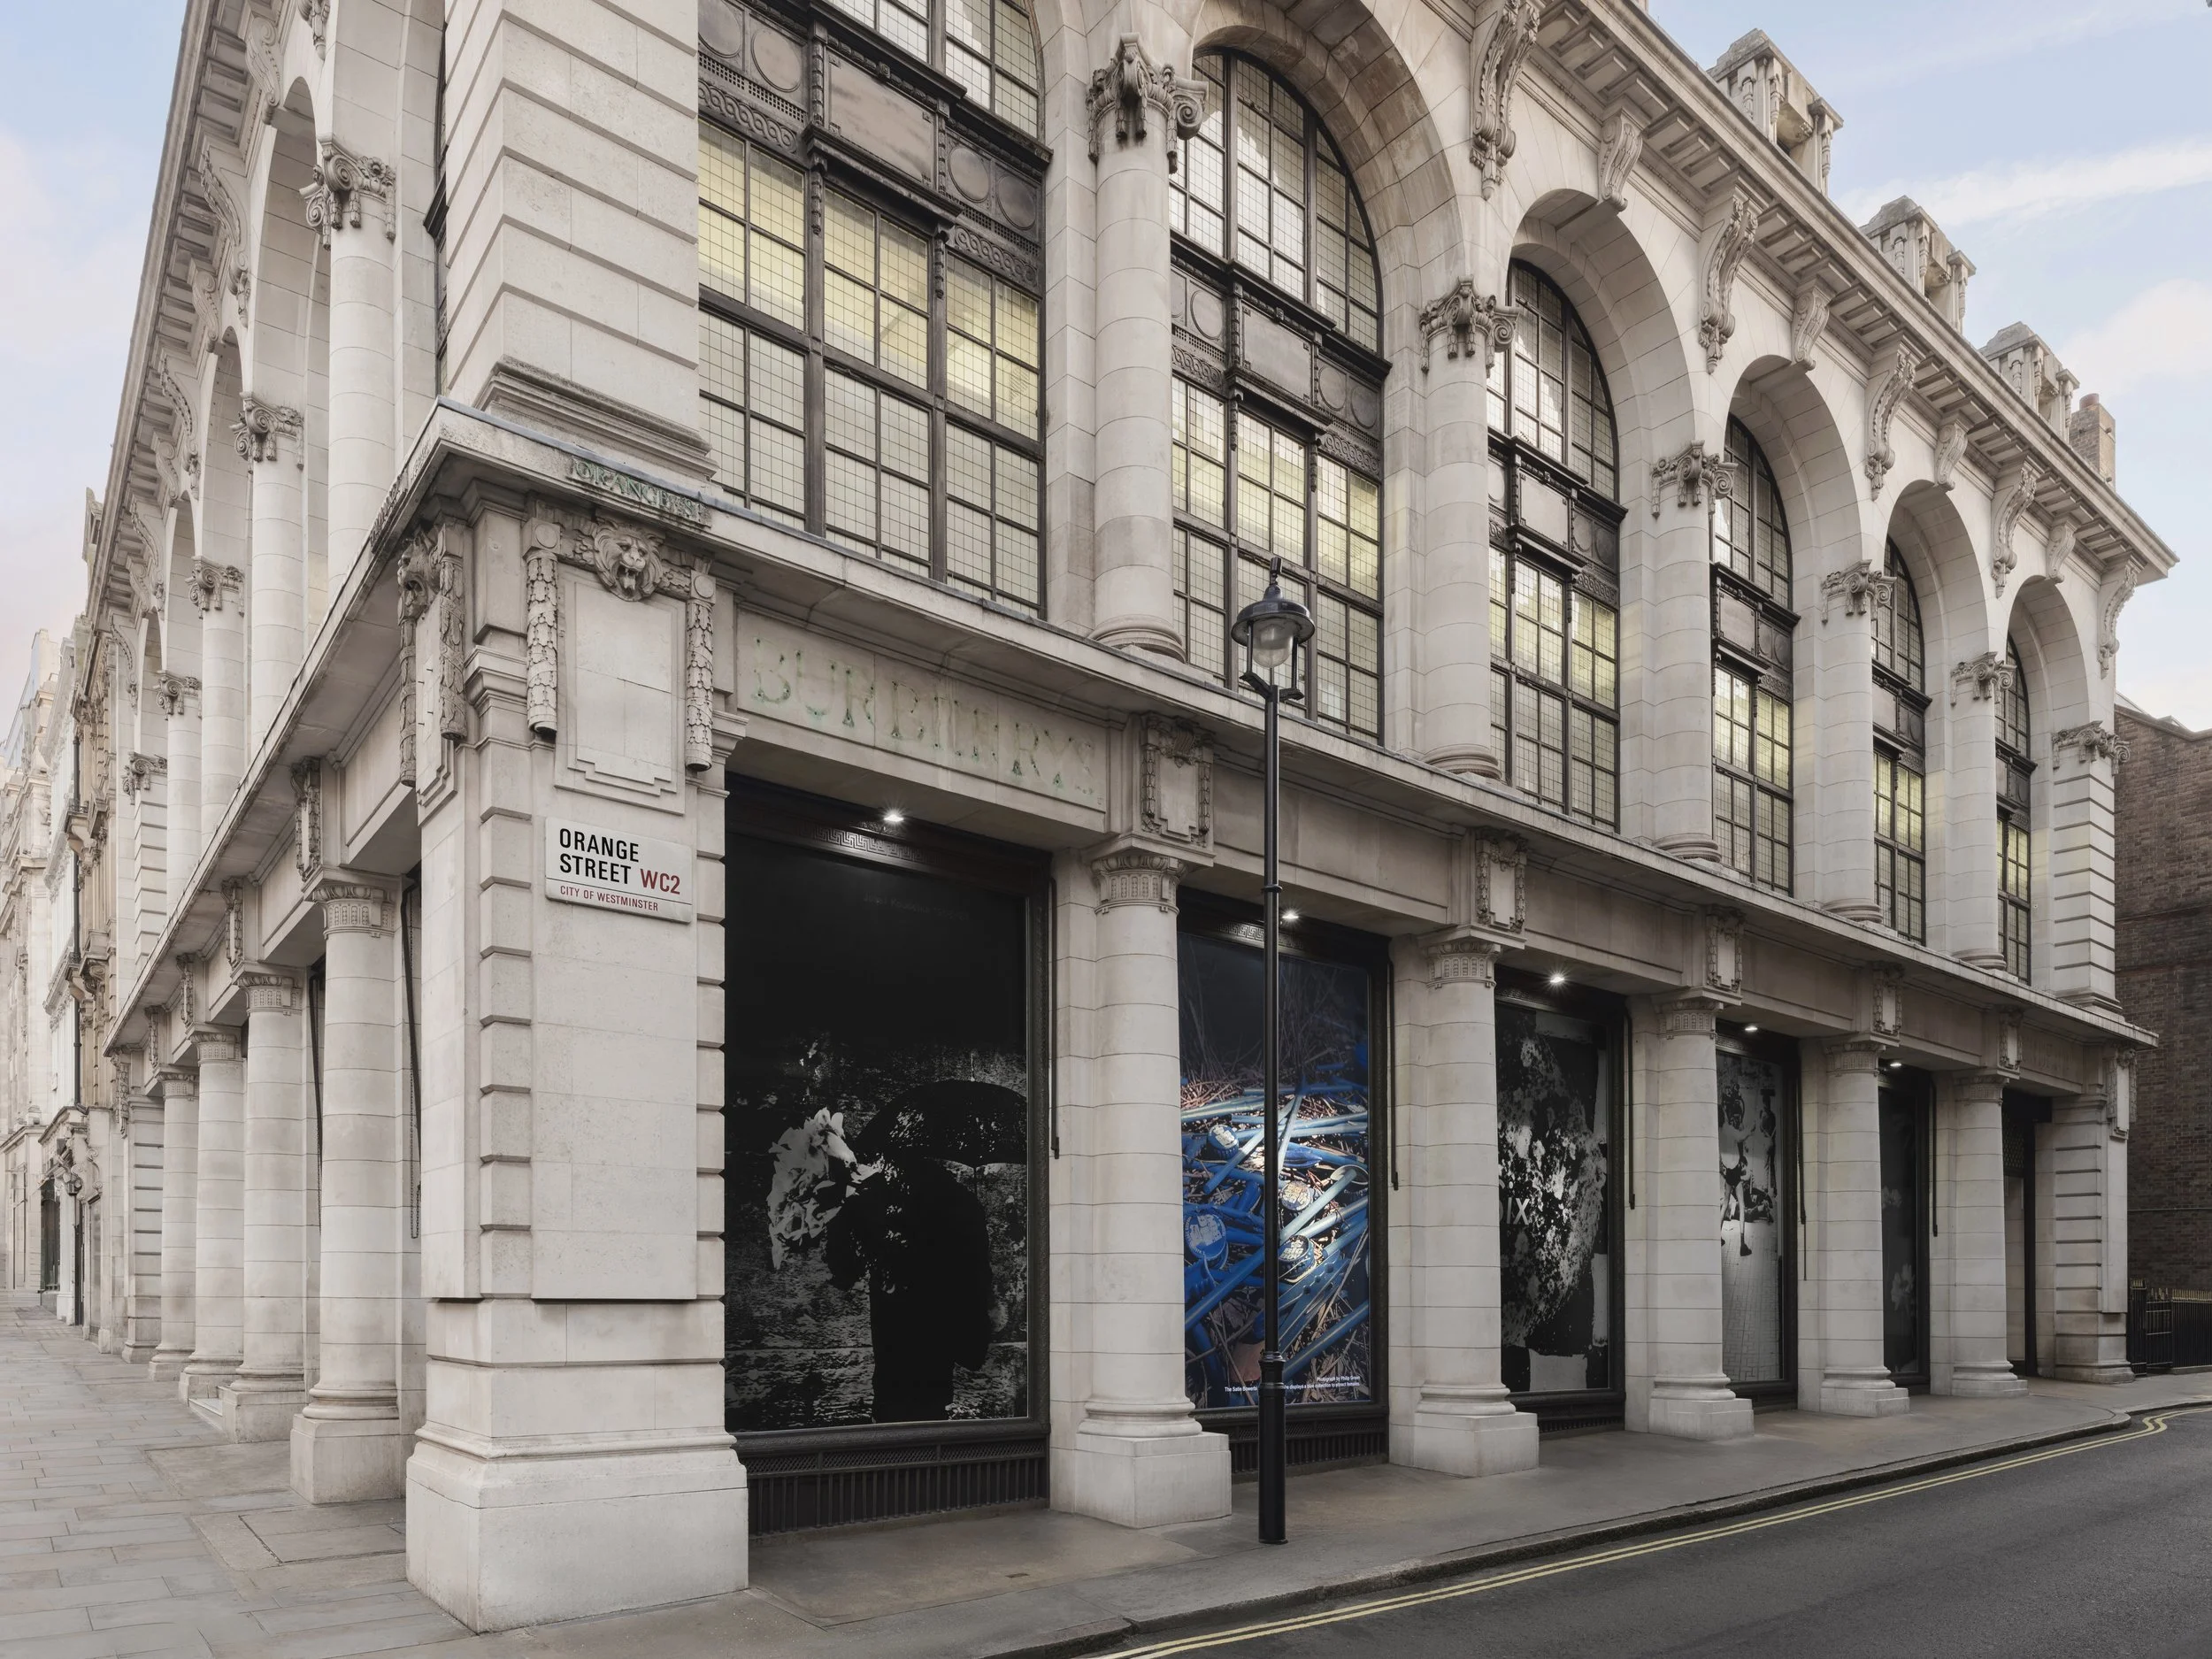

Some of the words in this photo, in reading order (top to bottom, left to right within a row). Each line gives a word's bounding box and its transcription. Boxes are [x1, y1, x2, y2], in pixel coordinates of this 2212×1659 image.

[560, 828, 639, 863] ORANGE
[560, 853, 631, 885] STREET
[641, 868, 680, 895] WC2
[560, 885, 580, 897] CITY
[584, 889, 594, 900] OF
[597, 892, 658, 911] WESTMINSTER
